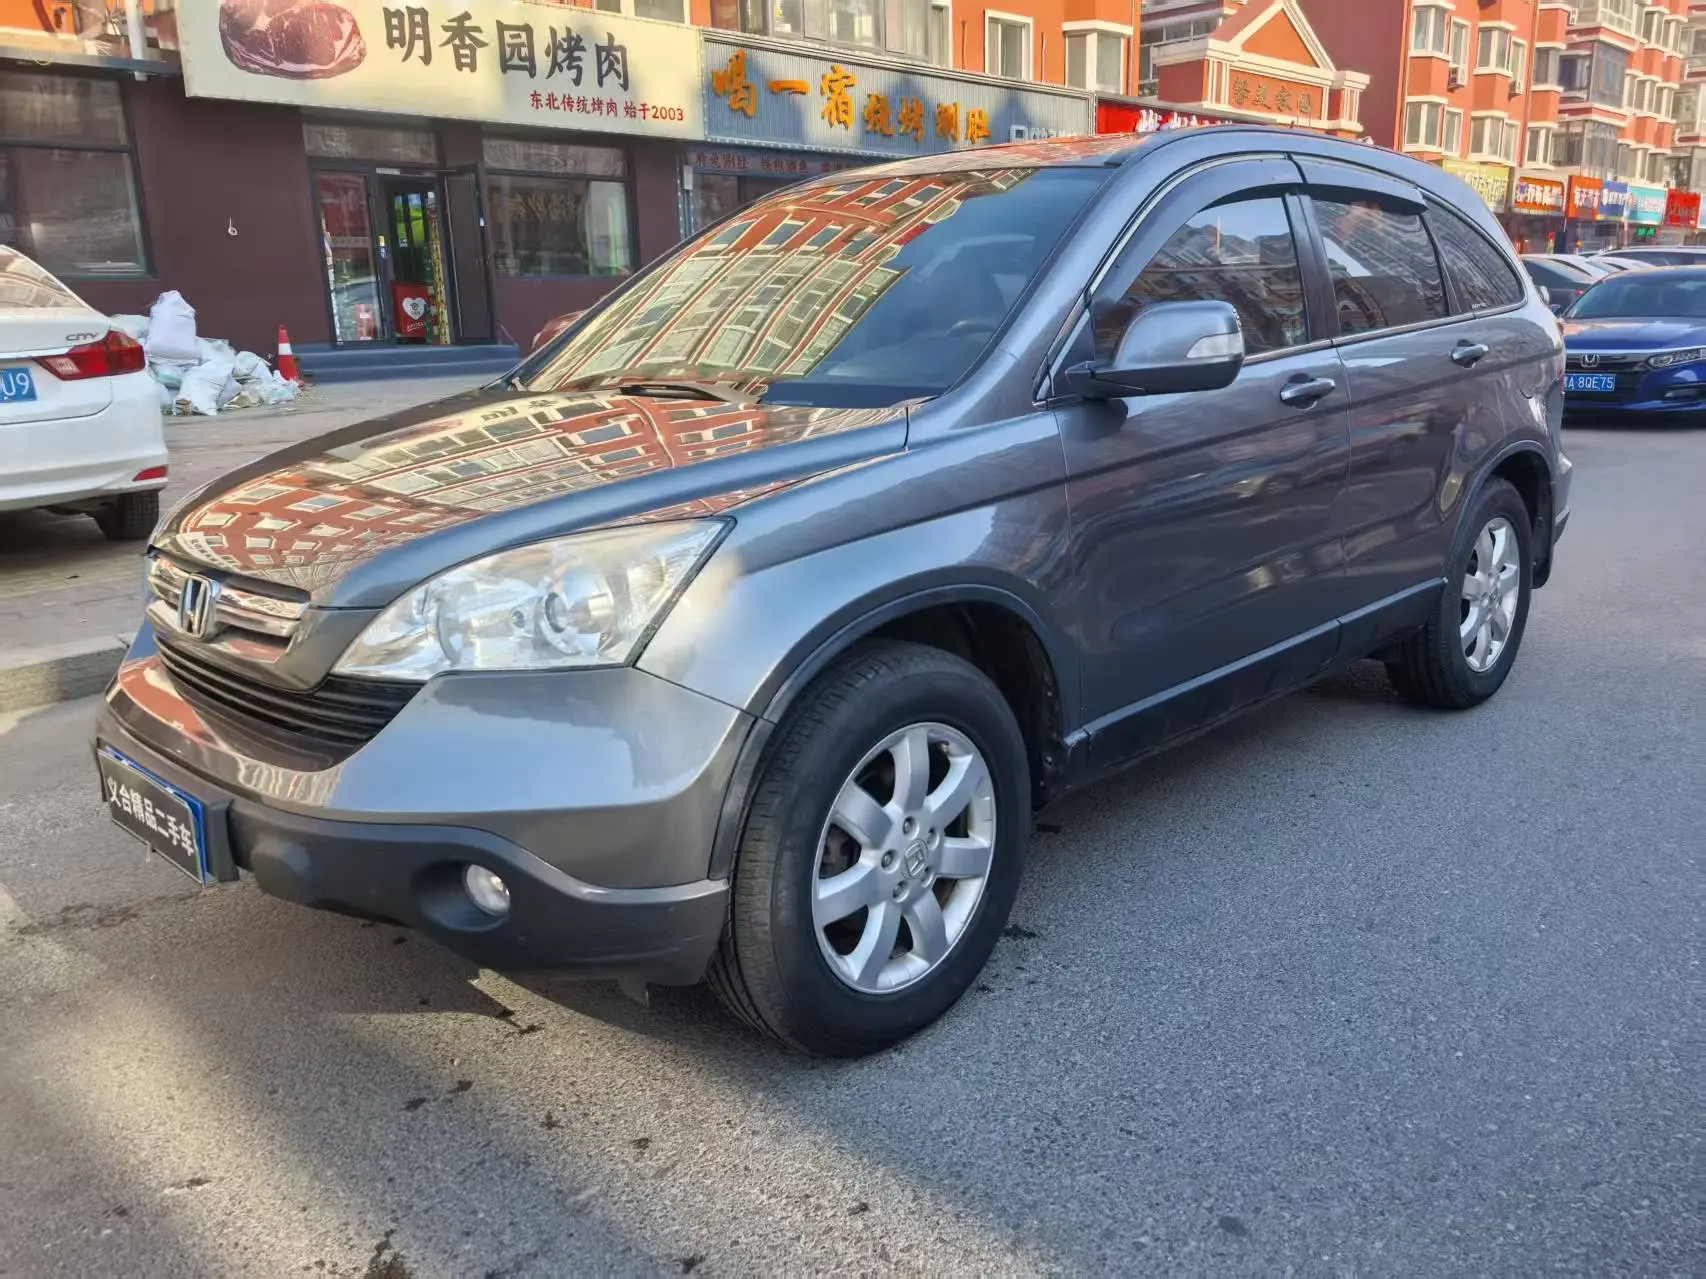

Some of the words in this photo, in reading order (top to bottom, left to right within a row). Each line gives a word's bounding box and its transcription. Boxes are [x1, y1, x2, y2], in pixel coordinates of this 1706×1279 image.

[383, 7, 629, 92] 明香园烤肉
[530, 90, 618, 117] 东北传统烤肉
[624, 101, 684, 121] 始于2003
[0, 373, 29, 396] U9
[1578, 376, 1613, 389] 8QE75
